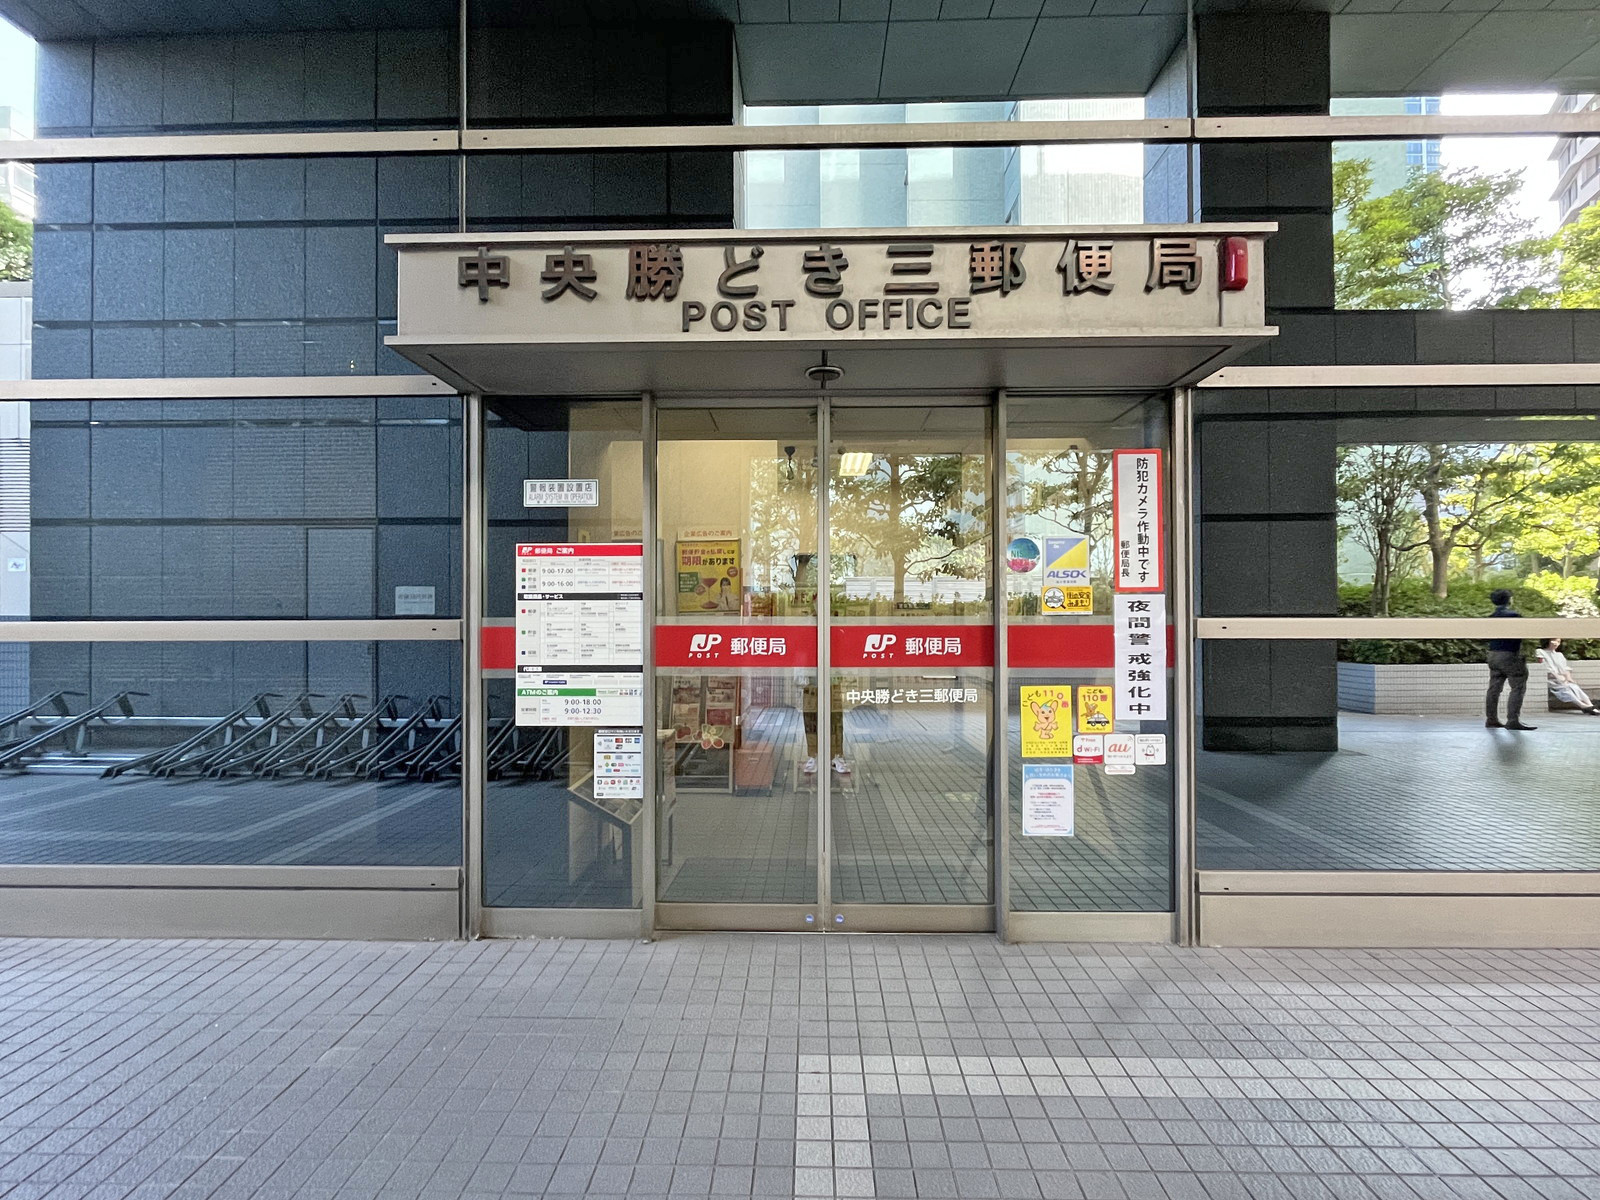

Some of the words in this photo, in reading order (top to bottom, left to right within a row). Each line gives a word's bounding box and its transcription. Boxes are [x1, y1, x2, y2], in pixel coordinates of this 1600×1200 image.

[457, 239, 1202, 302] 中央勝どき三郵便局
[682, 300, 796, 332] POST
[825, 296, 972, 330] OFFICE
[530, 483, 592, 493] 警報装置設置店
[1136, 457, 1150, 583] 防犯カメラ作動中です
[681, 556, 735, 566] 期限があります
[1120, 540, 1130, 578] 郵便局長
[1047, 570, 1087, 578] ALSOK
[730, 638, 786, 656] 郵便局
[905, 637, 961, 656] 郵便局
[1127, 600, 1152, 715] 夜間警戒強化中
[846, 688, 978, 704] 中央勝どき三郵便局
[1108, 743, 1131, 753] au
